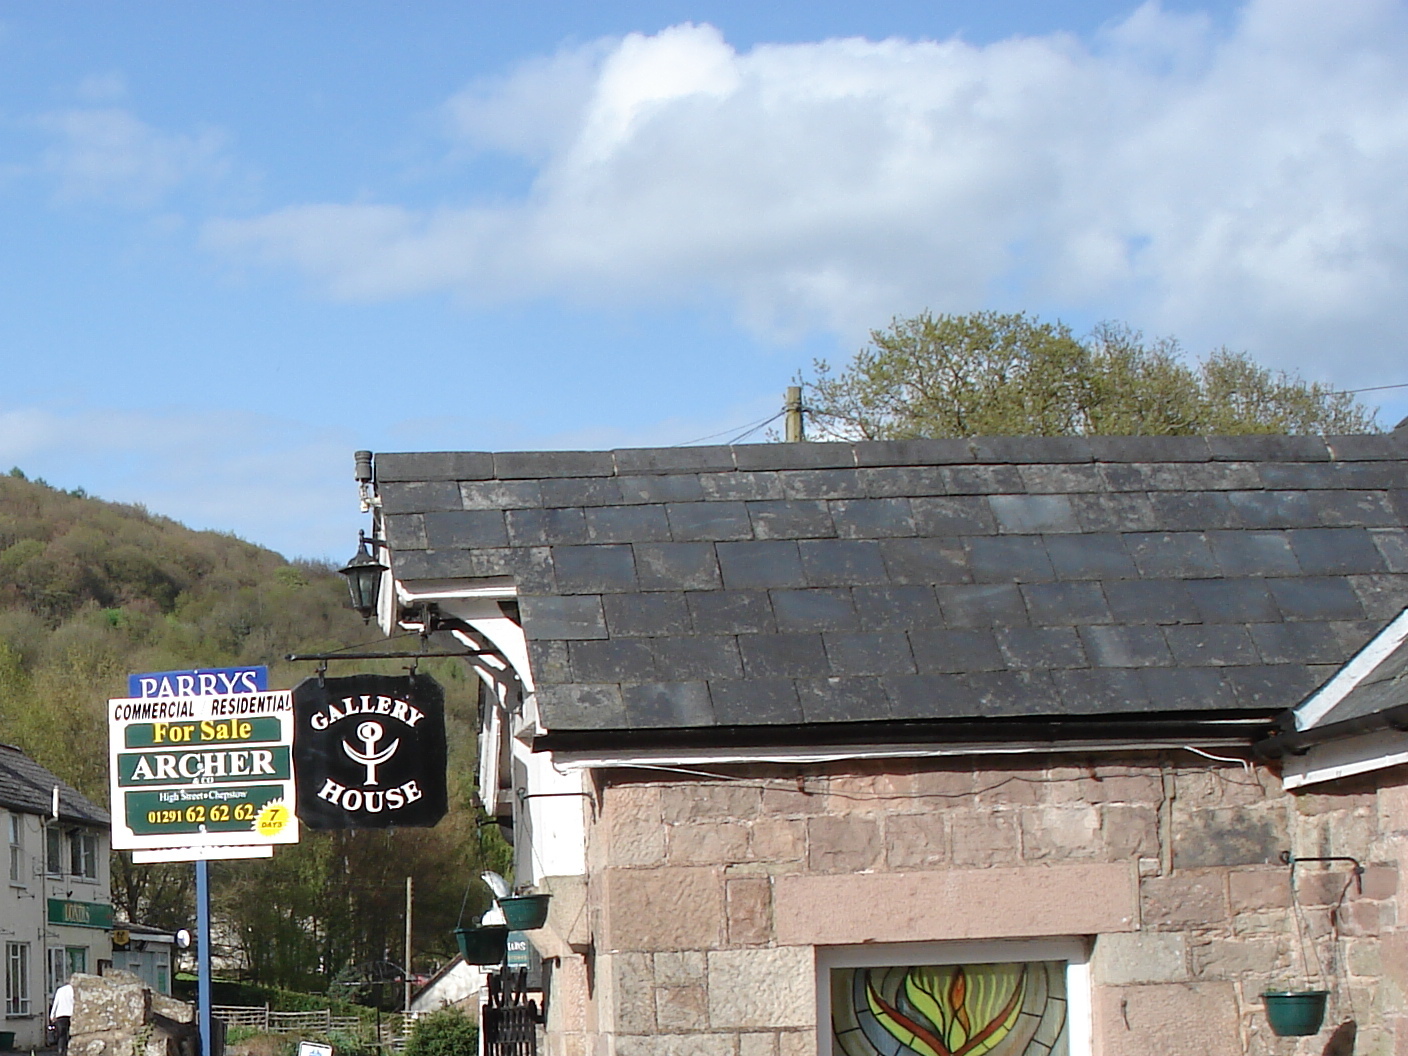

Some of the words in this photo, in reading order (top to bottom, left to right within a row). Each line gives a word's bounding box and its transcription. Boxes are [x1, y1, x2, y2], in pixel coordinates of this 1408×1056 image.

[139, 671, 258, 698] PARRYS
[114, 700, 195, 721] COMMERCIAL
[211, 693, 292, 716] RESIDENTIAL
[310, 695, 425, 730] GALLERY
[152, 721, 195, 743] For
[200, 718, 252, 741] Sale
[130, 749, 276, 780] ARCHER
[159, 792, 180, 804] High
[180, 791, 204, 801] Street
[208, 789, 248, 802] Chepstow
[317, 778, 423, 813] HOUSE
[148, 810, 182, 824] 01291
[185, 805, 206, 823] 62
[209, 804, 230, 822] 62
[234, 803, 254, 821] 62
[261, 821, 283, 829] DAYS
[269, 809, 280, 821] 7
